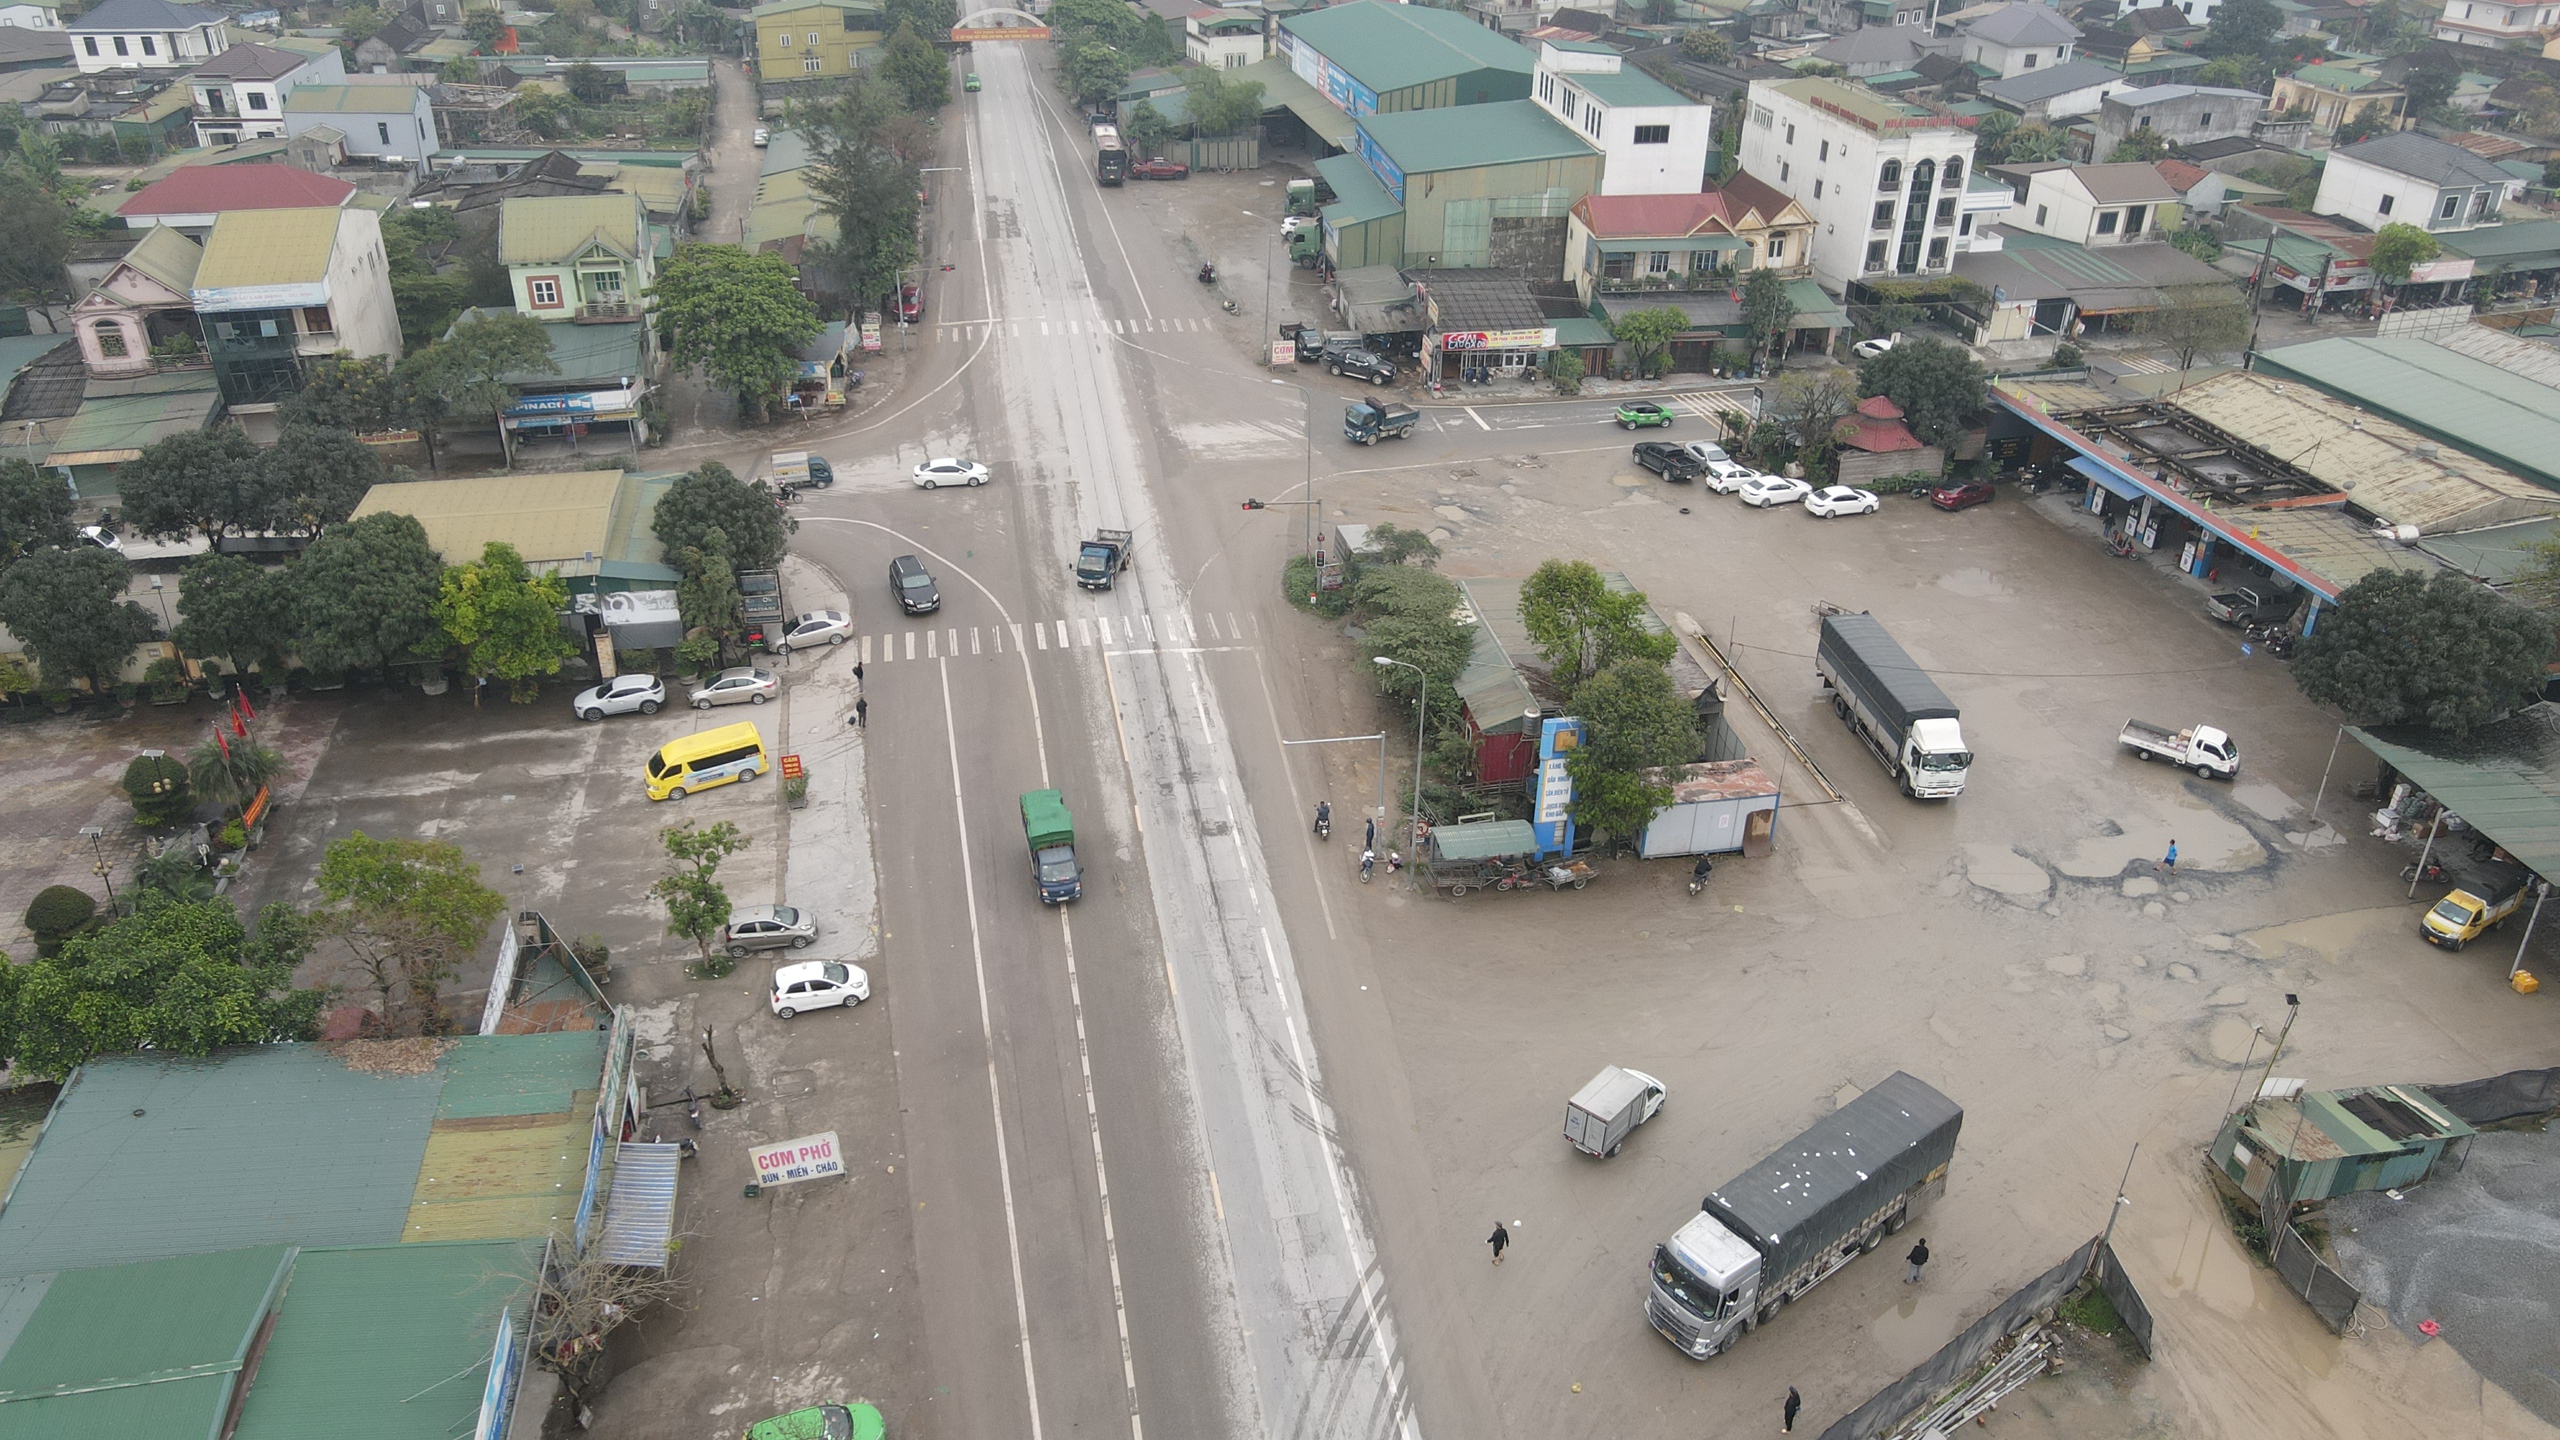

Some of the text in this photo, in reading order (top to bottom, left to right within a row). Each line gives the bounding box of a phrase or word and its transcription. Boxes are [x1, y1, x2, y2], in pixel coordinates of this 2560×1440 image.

[758, 1138, 832, 1170] CƠM PHỞ
[761, 1171, 780, 1184] BÚN
[815, 1160, 838, 1174] CHÁO
